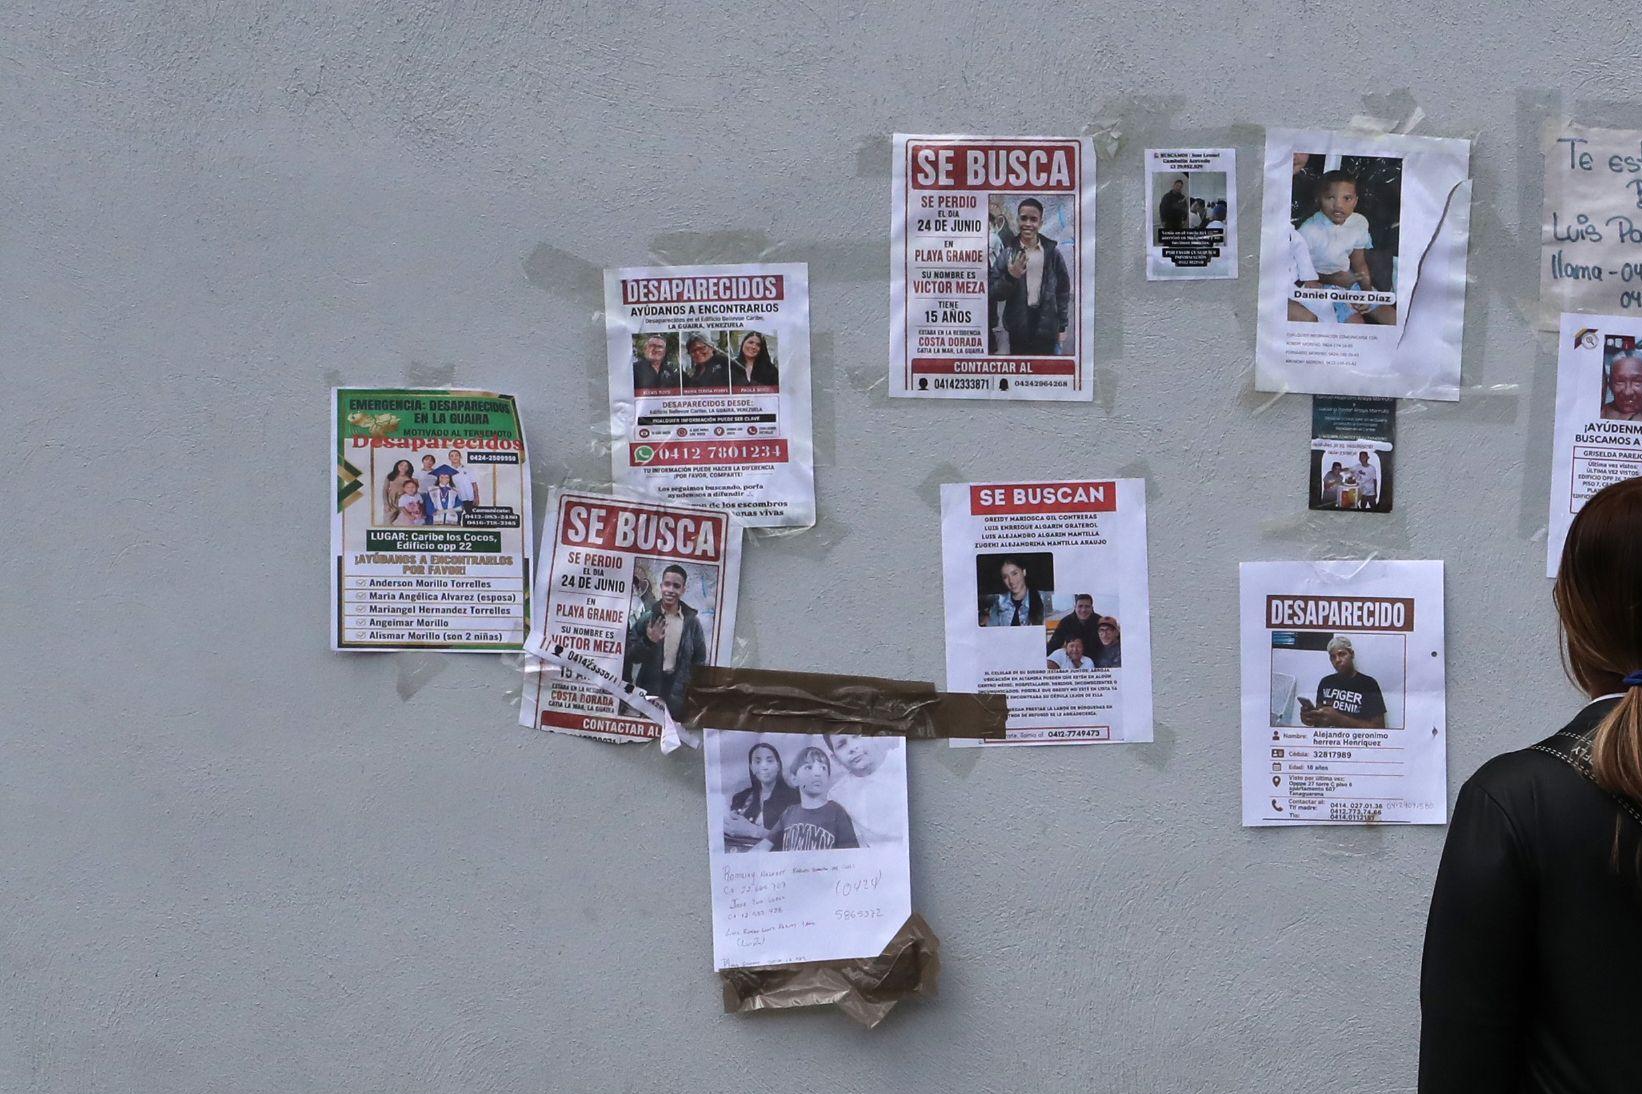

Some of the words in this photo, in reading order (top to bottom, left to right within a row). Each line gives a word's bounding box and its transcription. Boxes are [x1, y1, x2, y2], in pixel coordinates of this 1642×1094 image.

[1556, 137, 1594, 171] Te
[917, 149, 954, 186] SE
[966, 149, 1071, 187] BUSCA
[921, 195, 934, 208] SE
[938, 195, 977, 209] PERDIO
[917, 219, 931, 232] 24
[934, 219, 948, 232] DE
[950, 219, 982, 233] JUNIO
[1552, 211, 1603, 242] Luis
[915, 249, 944, 263] PLAYA
[946, 249, 983, 263] GRANDE
[1551, 249, 1603, 281] llama
[626, 276, 777, 303] DESAPARECIDOS
[913, 280, 953, 294] VICTOR
[955, 280, 986, 294] MEZA
[1294, 289, 1328, 300] Daniel
[1329, 292, 1366, 303] Quiroz
[1367, 292, 1392, 303] Díaz
[630, 303, 686, 317] AYÚDANOS
[688, 304, 696, 315] A
[698, 302, 779, 315] ENCONTRARLOS
[924, 310, 938, 323] 15
[942, 308, 972, 324] AÑOS
[953, 361, 1017, 374] CONTACTAR
[1019, 361, 1033, 373] AL
[350, 400, 426, 411] EMERGENCIA:
[429, 400, 510, 414] DESAPARECIDOS
[662, 400, 726, 409] DESAPARECIDOS
[414, 413, 432, 424] EN
[435, 413, 446, 424] LA
[450, 413, 490, 425] GUAIRA
[352, 434, 525, 452] Desaparecidos
[1575, 434, 1631, 446] BUSCAMOS
[1632, 438, 1641, 447] A
[659, 446, 701, 460] 0412
[1583, 450, 1616, 459] GRISELDA
[979, 488, 1007, 506] SE
[1013, 486, 1105, 505] BUSCAN
[370, 532, 409, 542] LUGAR:
[411, 533, 445, 541] Caribe
[447, 533, 462, 542] los
[463, 534, 498, 543] Cocos,
[567, 505, 610, 546] SE
[615, 510, 716, 558] BUSCA
[397, 542, 435, 551] Edificio
[437, 543, 456, 552] opp
[459, 542, 472, 551] 22
[567, 551, 582, 566] SE
[584, 553, 623, 570] PERDIO
[369, 579, 413, 588] Anderson
[415, 579, 448, 588] Morillo
[450, 580, 492, 588] Torrelles
[561, 574, 577, 589] 24
[578, 576, 591, 590] DE
[594, 577, 626, 594] JUNIO
[399, 592, 438, 602] Angélica
[477, 593, 516, 603] (esposa)
[556, 604, 585, 621] PLAYA
[587, 606, 624, 624] GRANDE
[1271, 599, 1405, 627] DESAPARECIDO
[369, 631, 406, 640] Alismar
[408, 632, 441, 641] Morillo
[443, 632, 463, 642] (son
[465, 632, 472, 641] 2
[474, 632, 503, 642] niñas)
[560, 625, 571, 634] SU
[573, 626, 603, 638] NOMBRE
[605, 630, 615, 639] ES
[551, 634, 592, 652] VICTOR
[593, 639, 623, 656] MEZA
[583, 718, 644, 736] CONTACTAR
[1313, 730, 1351, 739] Alejandro
[1312, 738, 1341, 746] herrera
